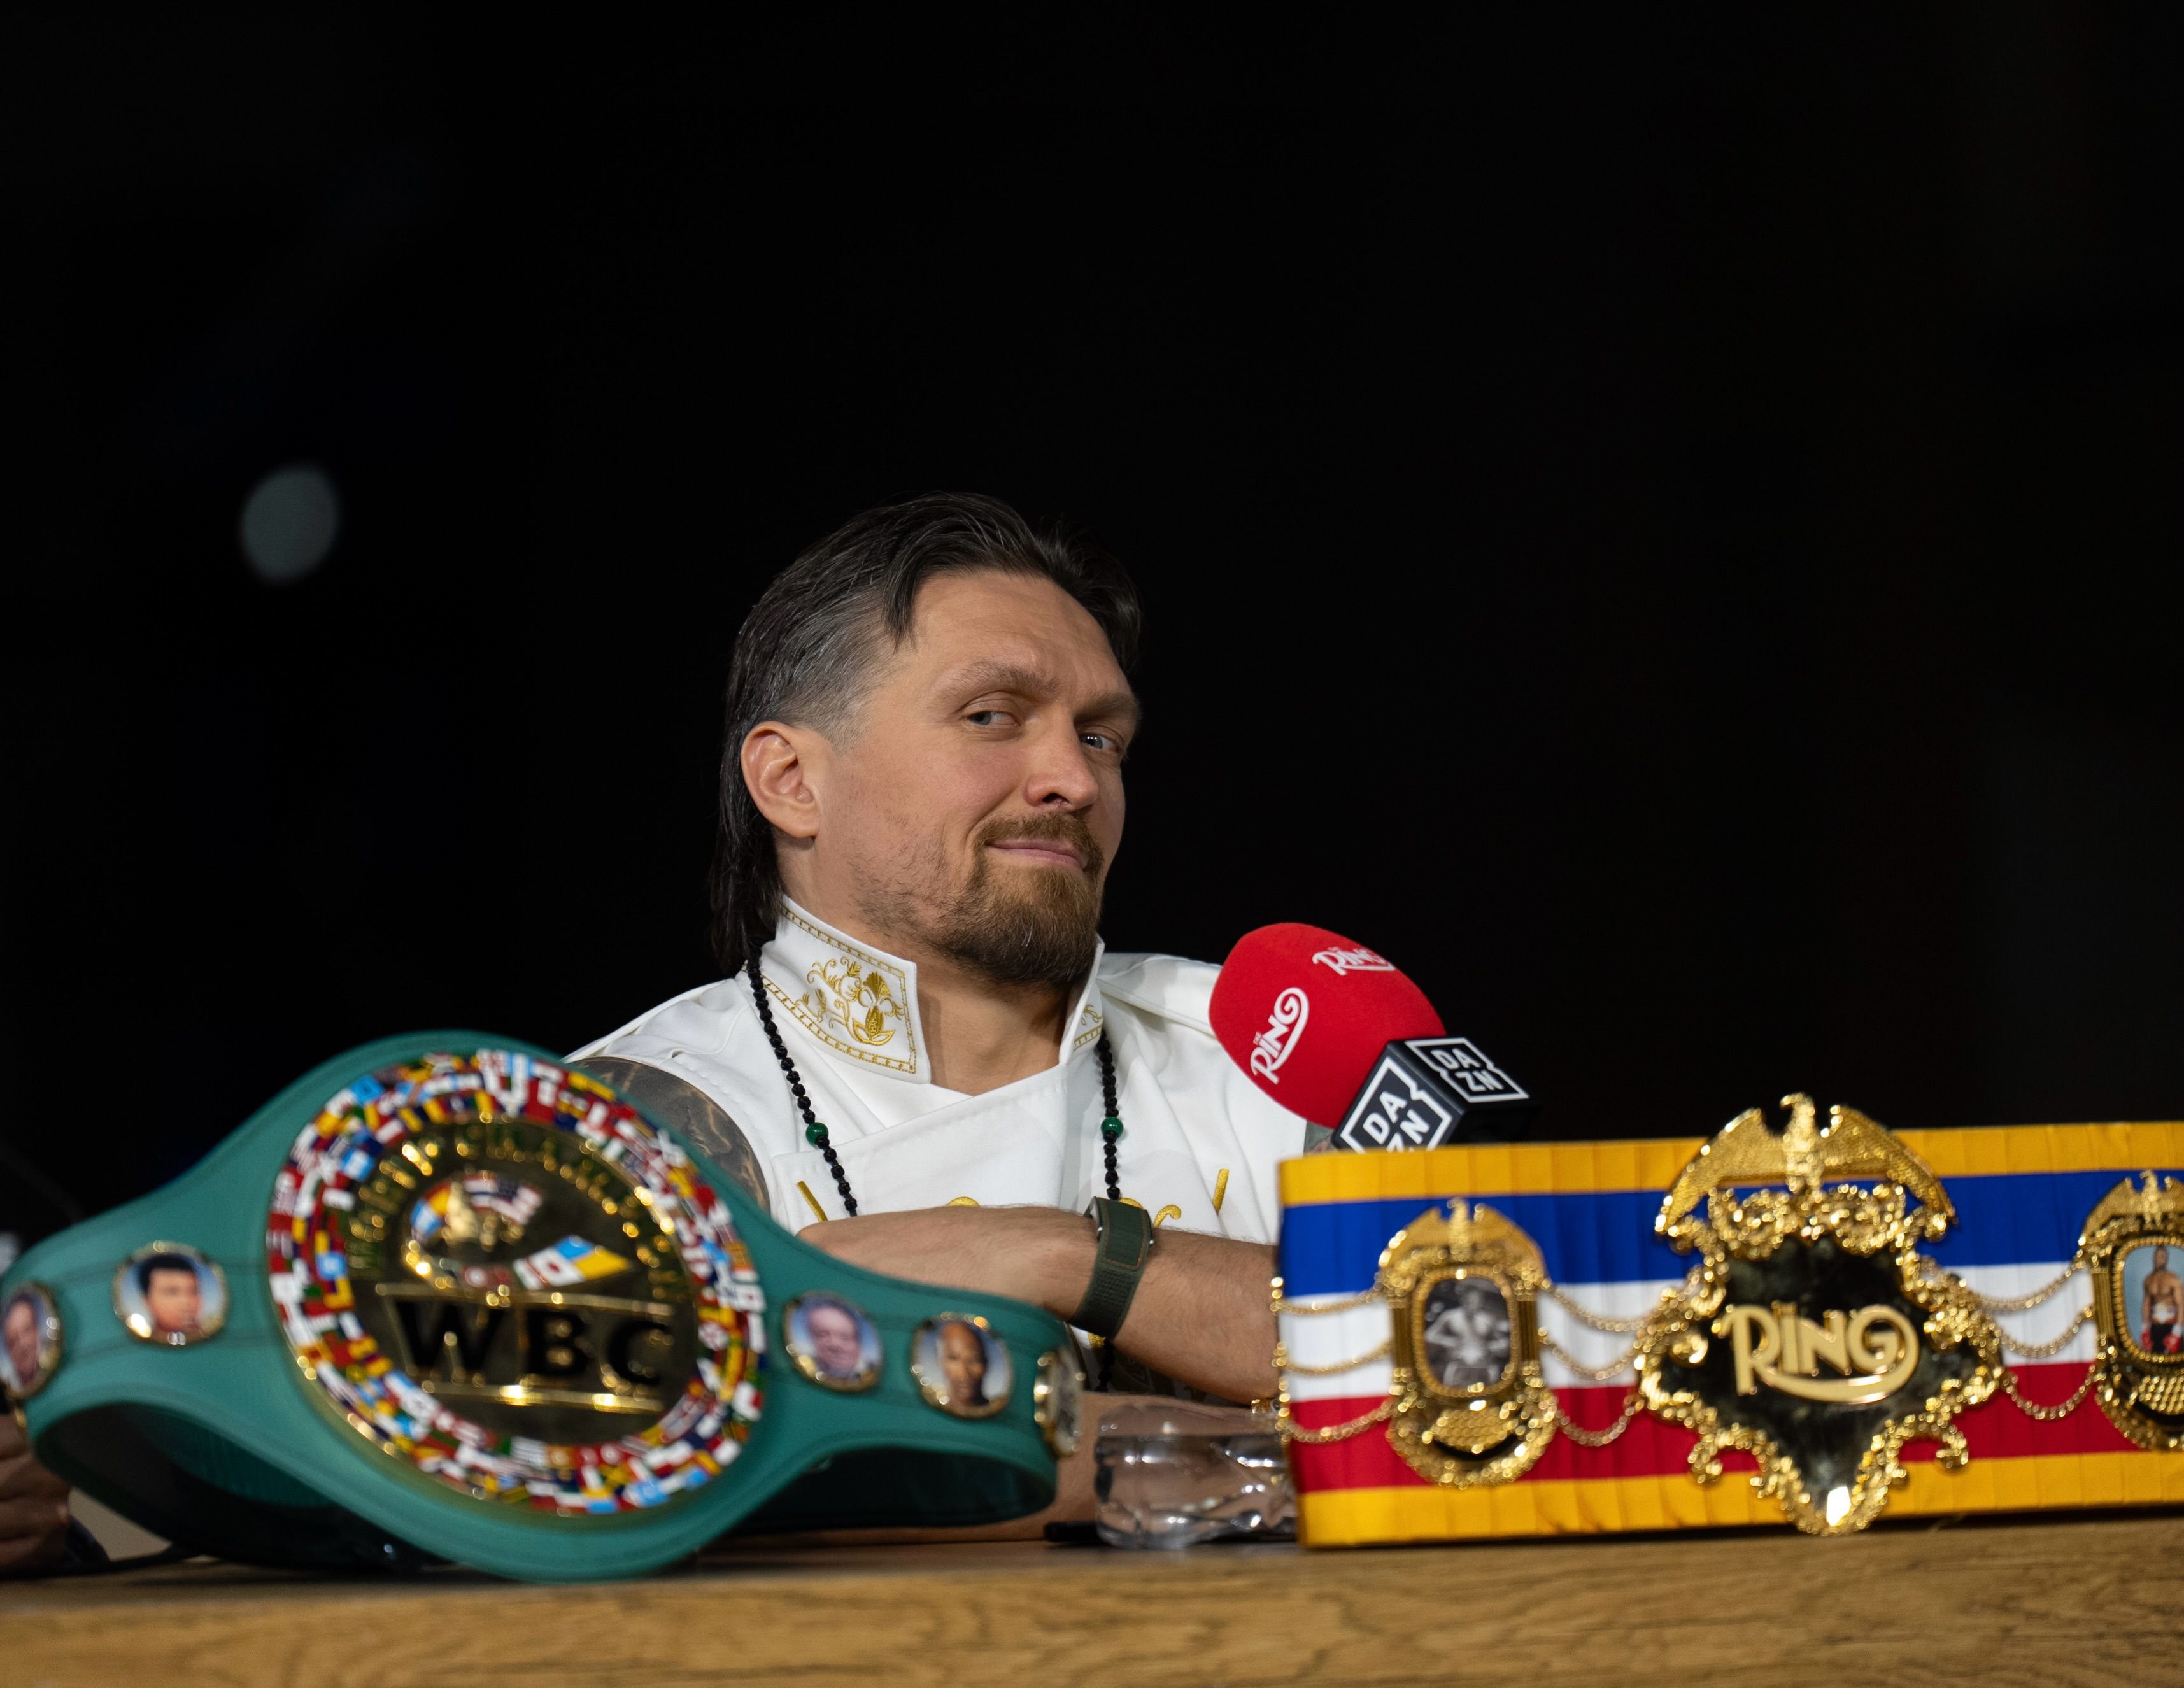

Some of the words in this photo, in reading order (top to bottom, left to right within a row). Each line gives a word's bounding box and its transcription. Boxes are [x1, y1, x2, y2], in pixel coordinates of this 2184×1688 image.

[1250, 987, 1310, 1085] RING
[1430, 1047, 1482, 1070] DA
[1454, 1070, 1504, 1092] ZN
[1362, 1091, 1408, 1145] DA
[388, 1299, 672, 1387] WBC
[1713, 1304, 1919, 1404] RING
